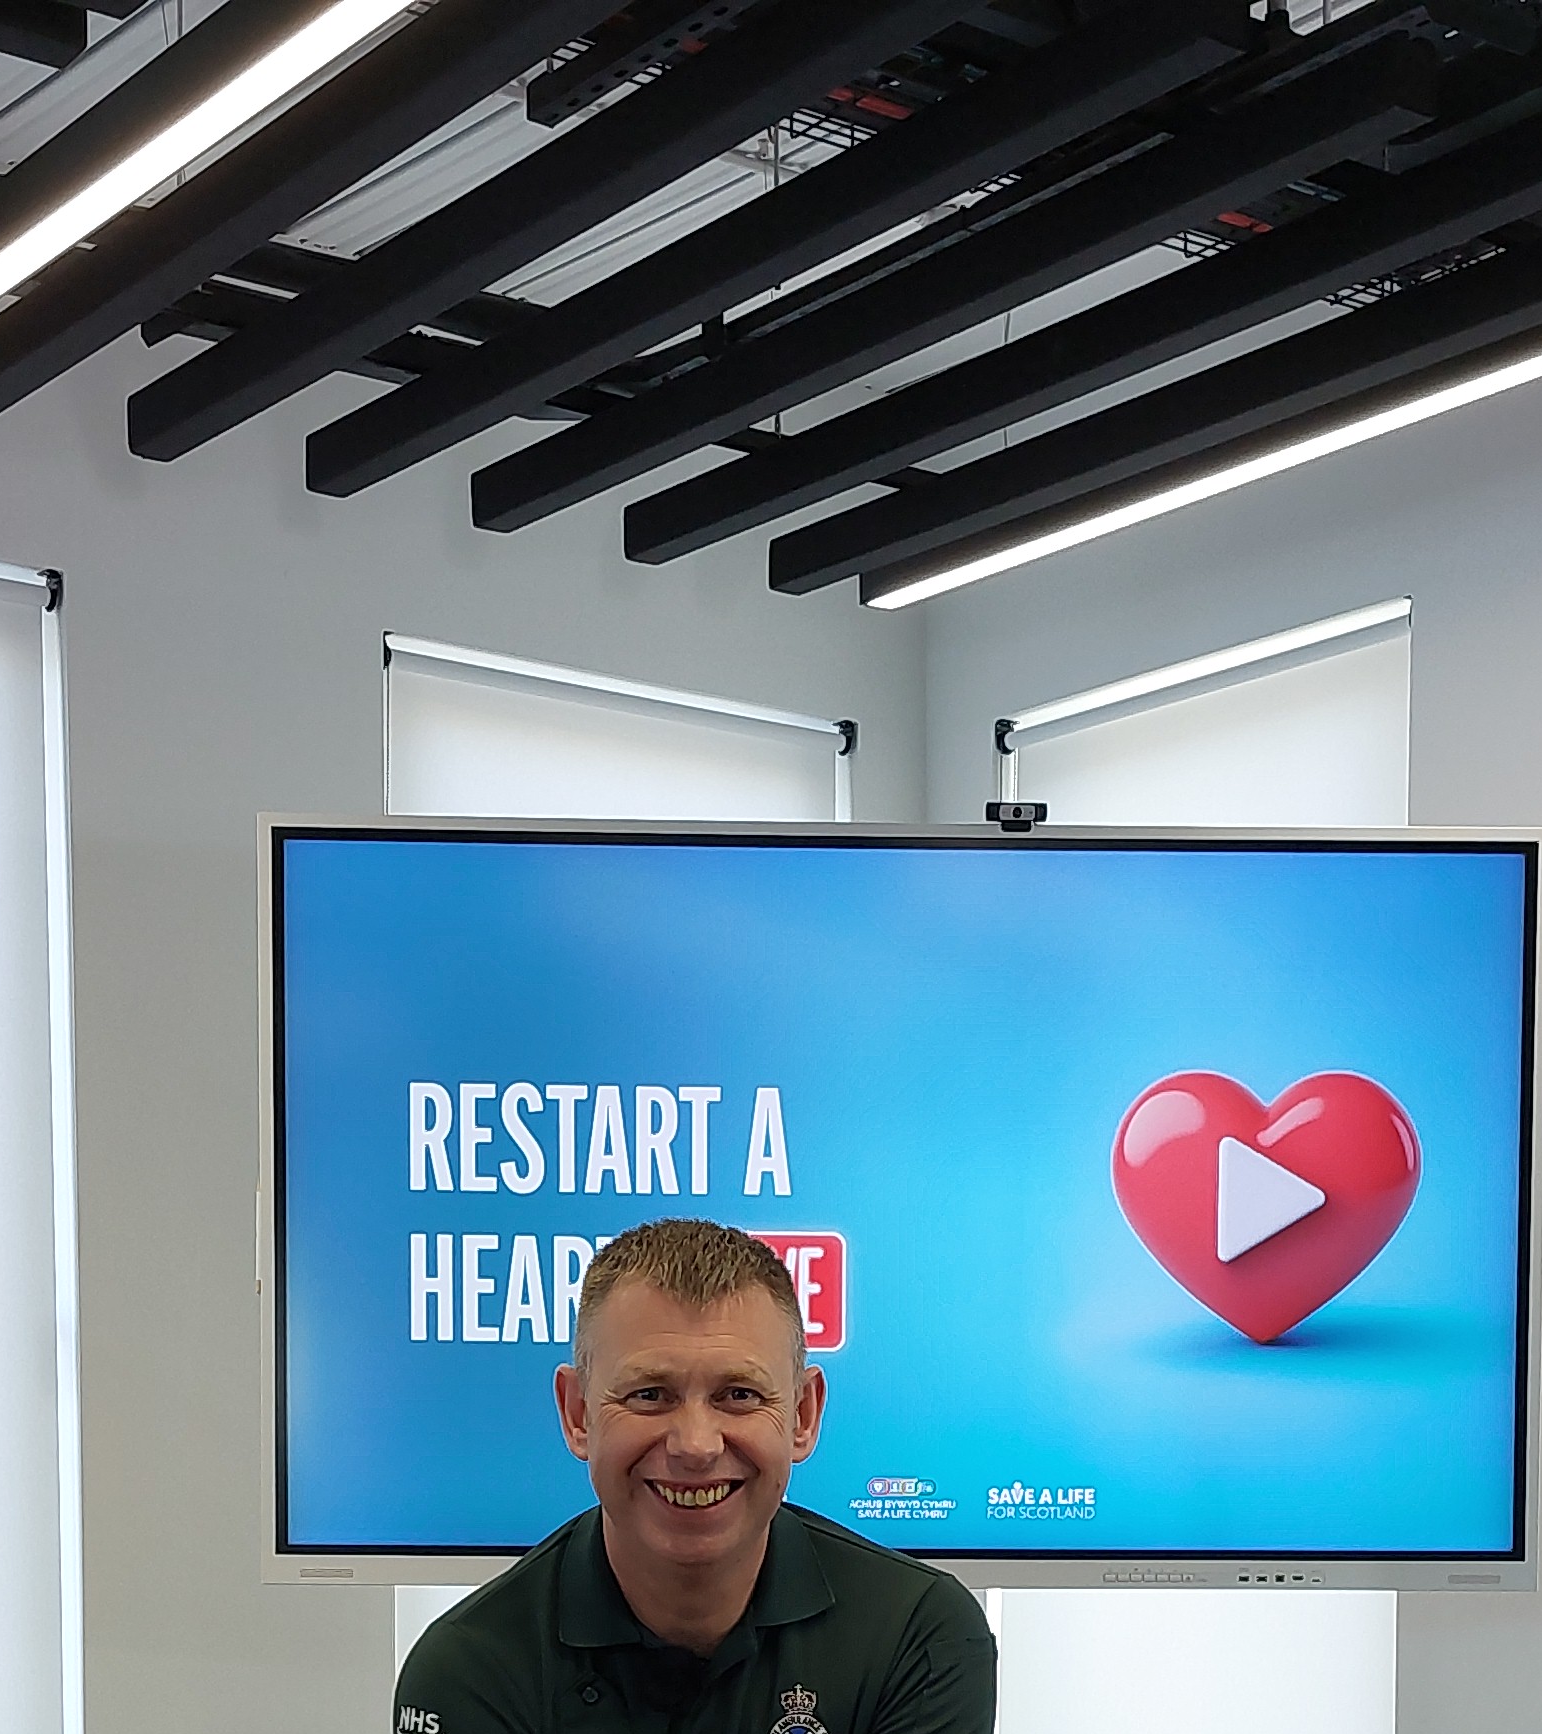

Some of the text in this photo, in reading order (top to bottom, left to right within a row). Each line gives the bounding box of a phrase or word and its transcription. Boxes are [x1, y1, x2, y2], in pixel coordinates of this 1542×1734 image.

[408, 1082, 792, 1196] RESTART A
[409, 1233, 615, 1343] HEAR
[988, 1482, 1096, 1505] SAVE A LIFE
[858, 1509, 948, 1519] SAVE A LIFE CYMRU
[987, 1506, 1095, 1519] FOR SCOTLAND
[399, 1705, 441, 1734] NHS
